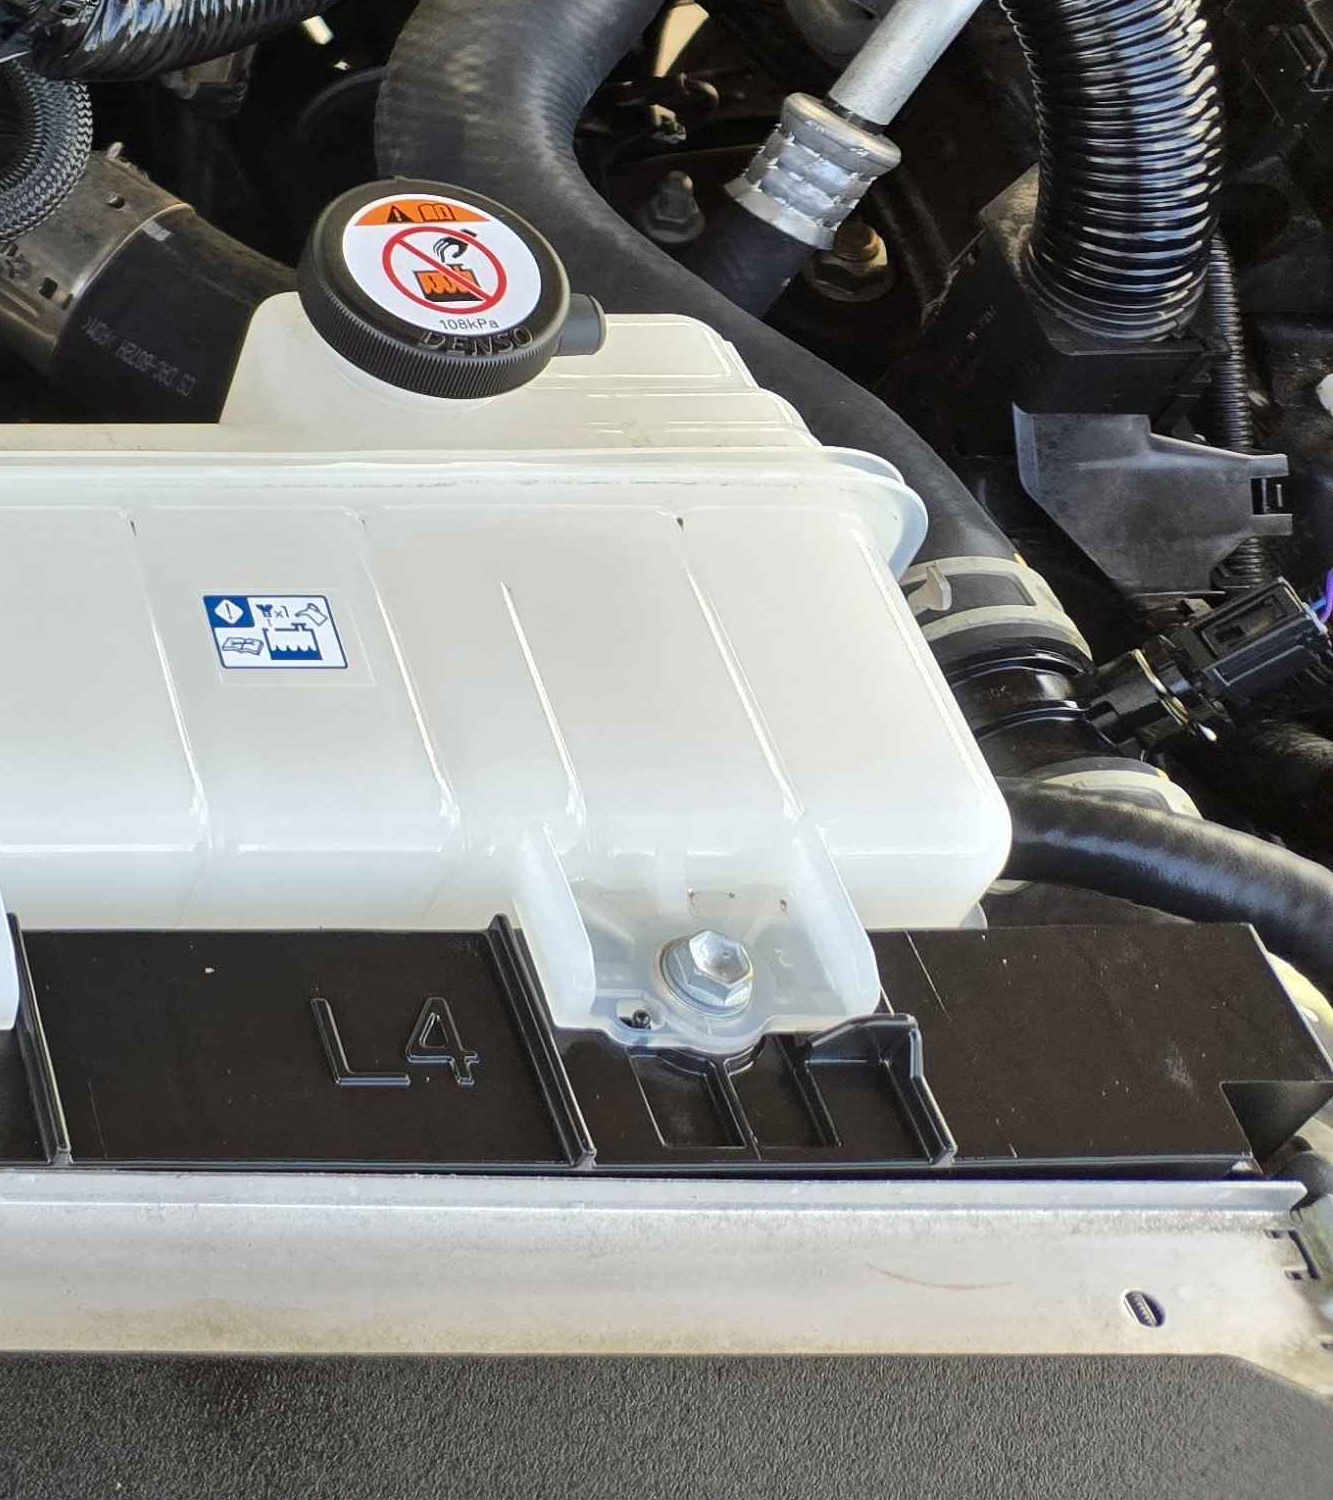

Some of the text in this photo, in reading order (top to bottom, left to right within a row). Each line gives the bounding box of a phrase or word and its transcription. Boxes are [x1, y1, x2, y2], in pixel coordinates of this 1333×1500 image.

[439, 318, 500, 331] 108kPa
[417, 325, 534, 357] DENSO
[310, 996, 480, 1086] L4
